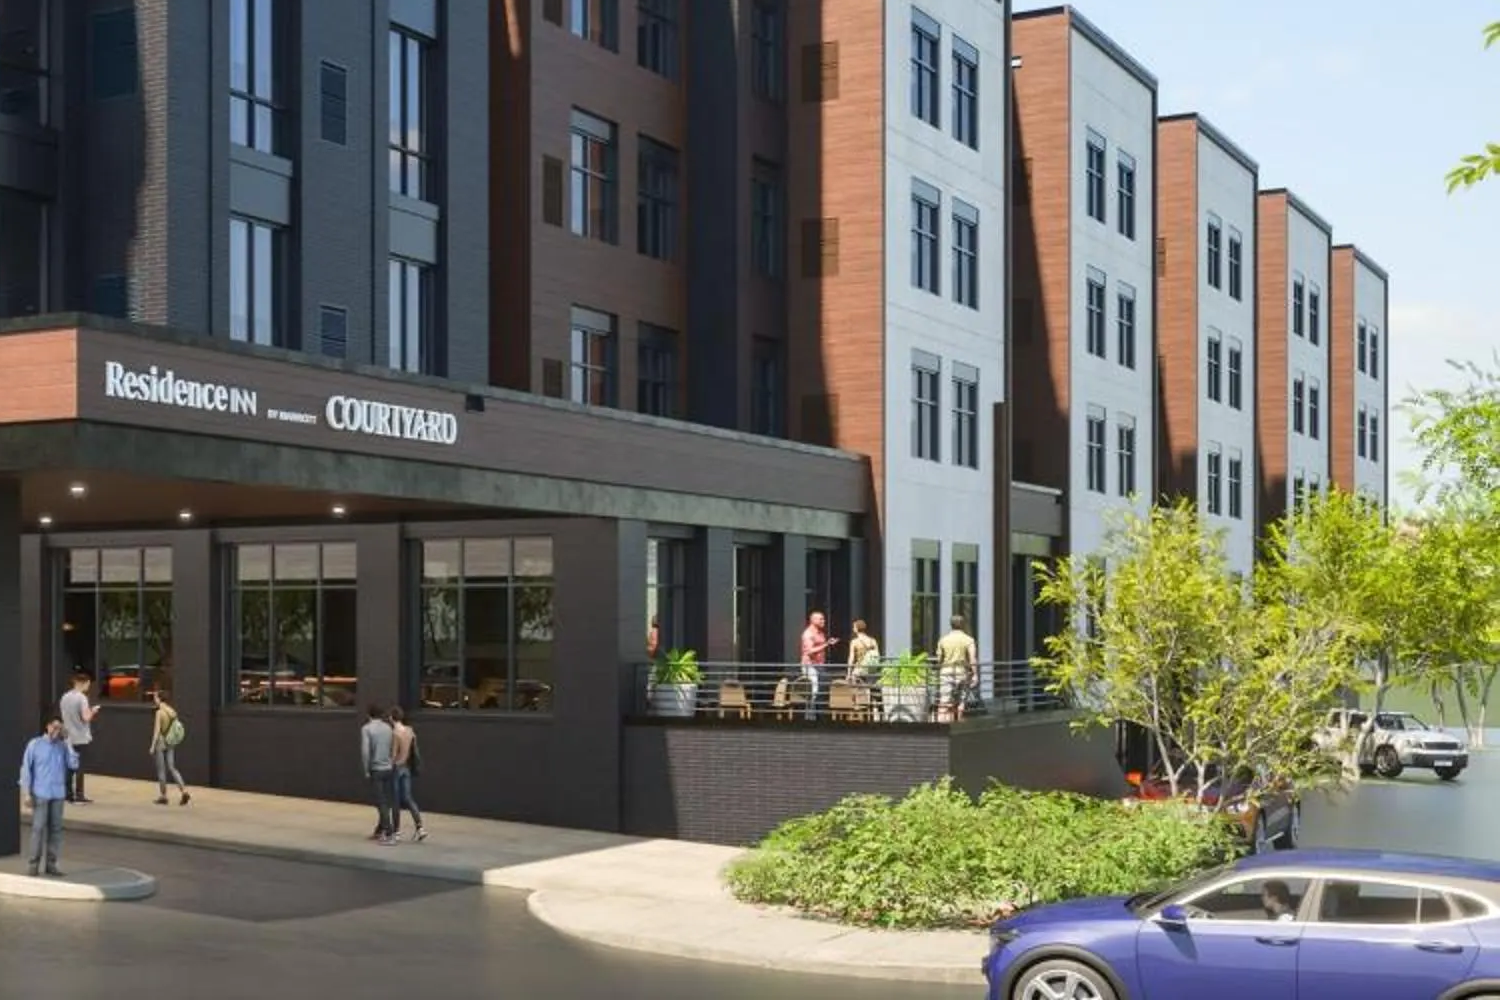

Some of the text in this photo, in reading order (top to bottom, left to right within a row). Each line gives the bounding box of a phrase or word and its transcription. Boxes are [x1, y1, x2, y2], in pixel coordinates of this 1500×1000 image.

[105, 361, 258, 416] Residence INN
[325, 395, 458, 445] COURTYARD
